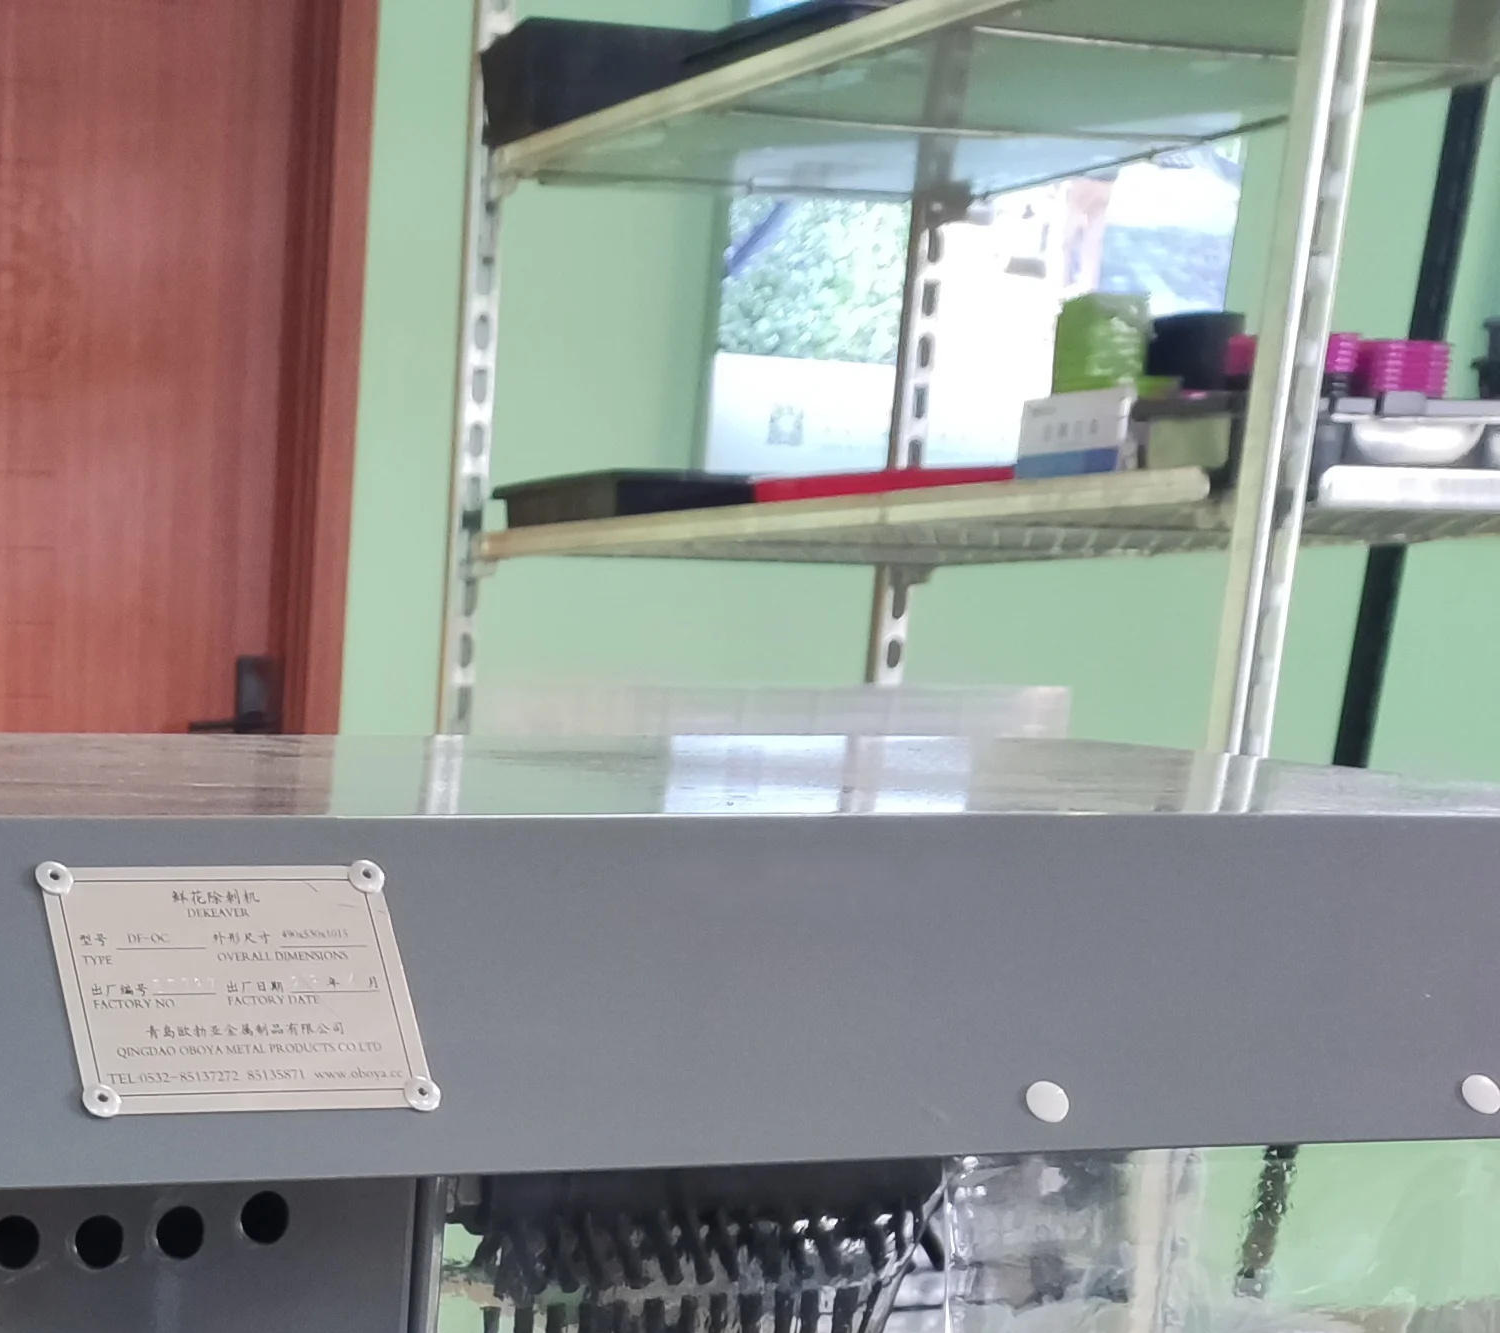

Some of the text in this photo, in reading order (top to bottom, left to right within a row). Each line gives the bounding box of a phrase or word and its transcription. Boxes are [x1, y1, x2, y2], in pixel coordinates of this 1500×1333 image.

[171, 888, 261, 905] 鲜花除刺机
[79, 932, 108, 947] 型号
[212, 930, 271, 945] 外形尺寸
[81, 955, 113, 965] TYPE
[217, 950, 349, 962] OVERALL DIMENSIONS
[91, 983, 149, 997] 出厂编号
[226, 980, 284, 994] 出厂日期
[326, 975, 341, 991] 年
[367, 975, 379, 989] 月
[93, 999, 176, 1010] FACTORY NO
[227, 994, 320, 1006] FACTORY DATE
[116, 1045, 177, 1060] QINGDAO
[179, 1044, 224, 1056] OBOYA
[225, 1043, 266, 1055] METAL
[268, 1042, 337, 1054] PRODUCTS
[247, 1069, 306, 1081] 85135871
